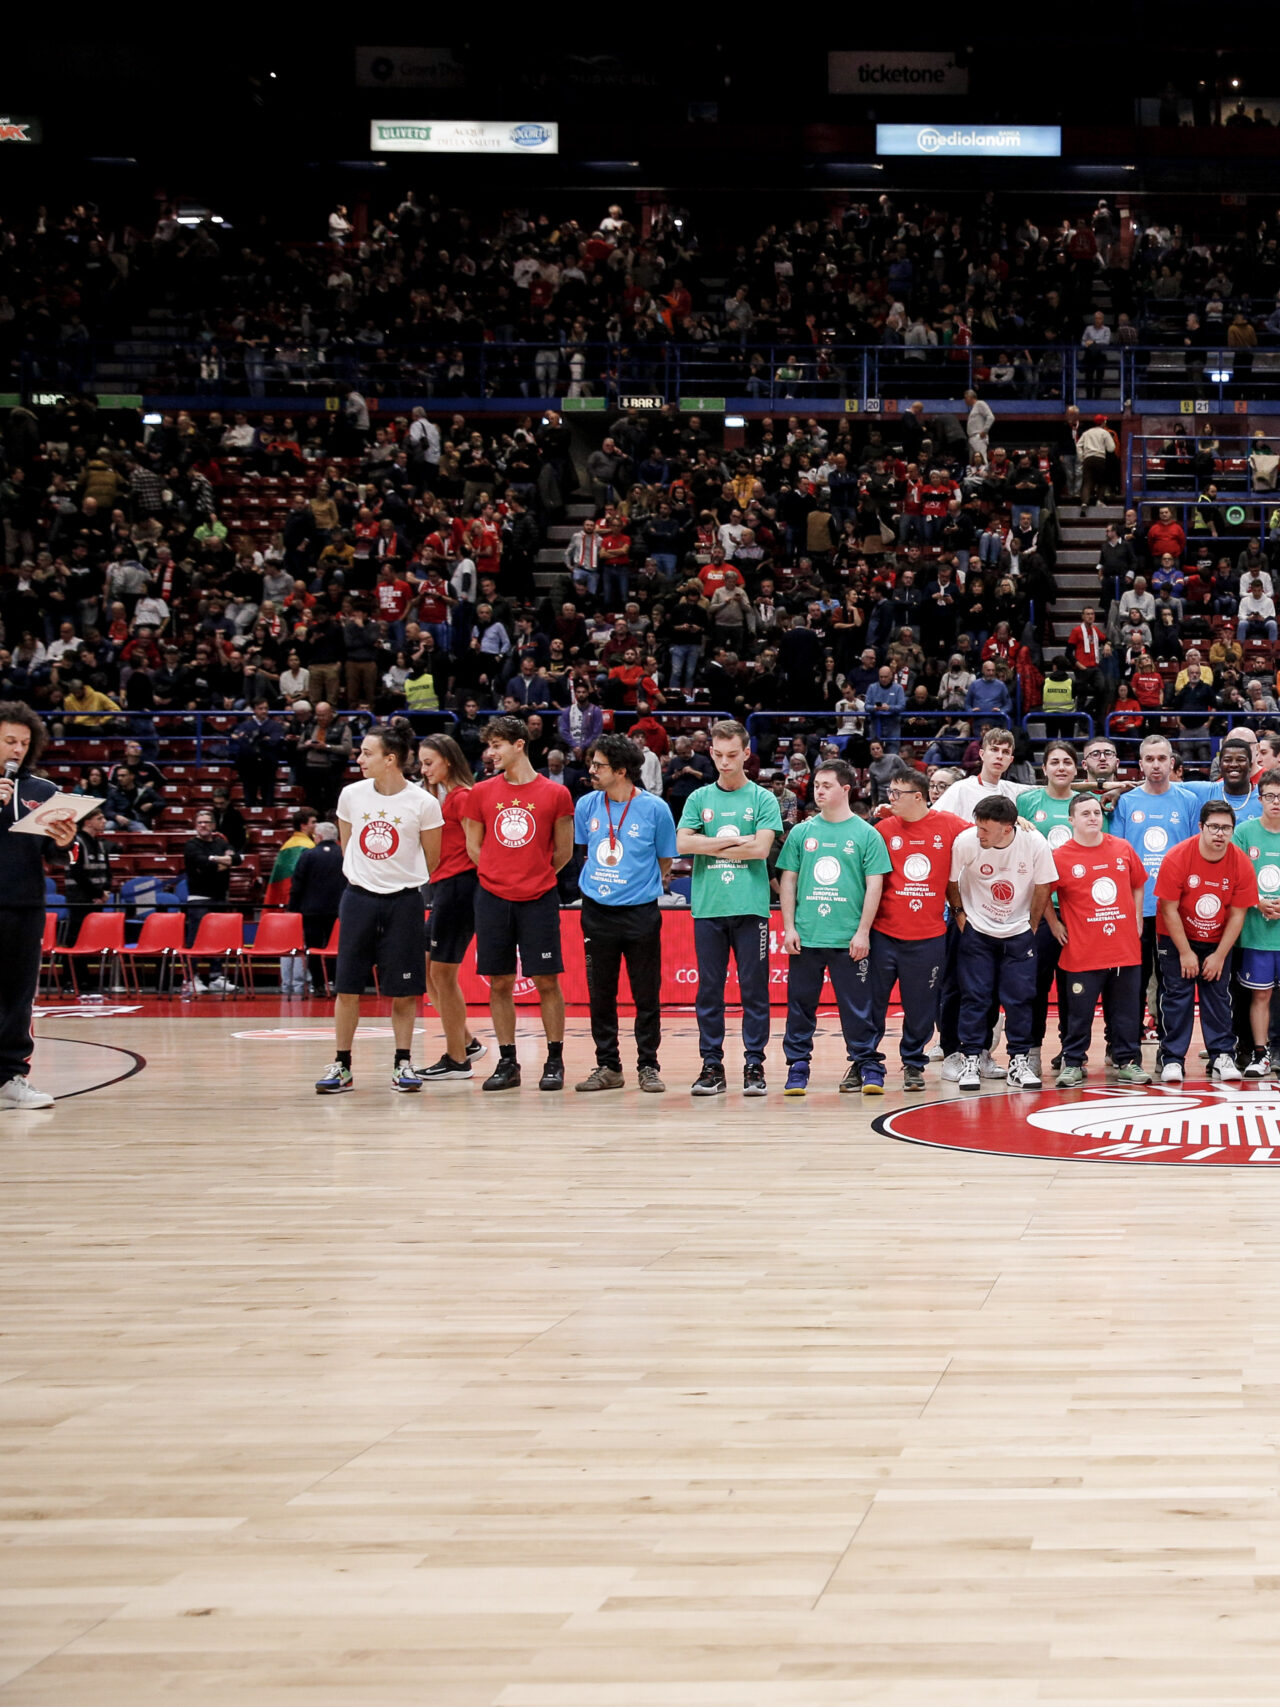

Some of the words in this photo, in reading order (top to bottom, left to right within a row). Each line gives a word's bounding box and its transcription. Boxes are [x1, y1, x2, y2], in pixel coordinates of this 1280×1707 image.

[858, 66, 945, 82] ticketone
[382, 126, 428, 140] ULIVETO
[921, 131, 1021, 147] mediolanum
[630, 398, 653, 408] BAR
[867, 401, 879, 410] 20
[1197, 403, 1208, 411] 21
[502, 809, 528, 818] OLIMPIA
[367, 821, 393, 831] OLIMPIA
[1086, 914, 1115, 923] BASKETBALL
[758, 922, 768, 961] Joma
